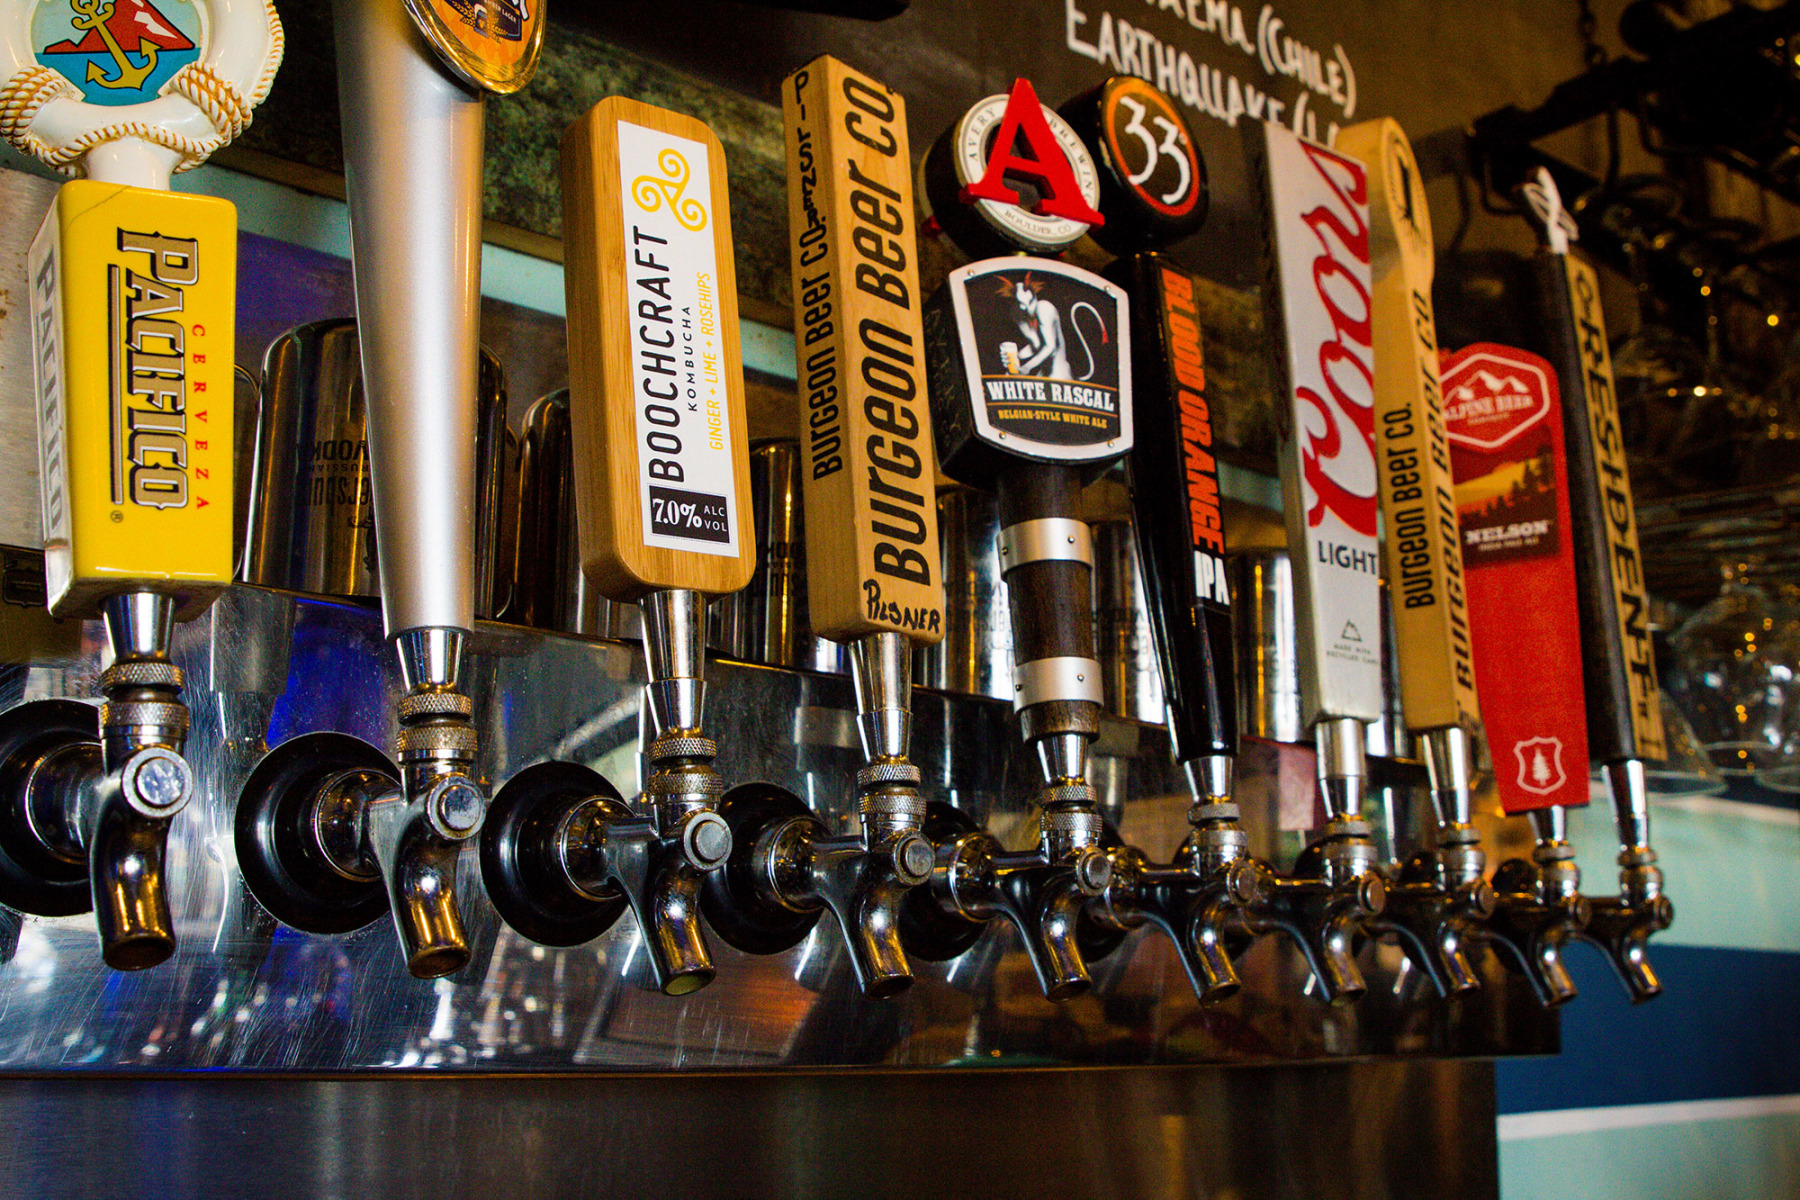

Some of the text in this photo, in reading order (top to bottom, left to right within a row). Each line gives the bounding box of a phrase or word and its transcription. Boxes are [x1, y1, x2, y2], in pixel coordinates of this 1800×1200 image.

[968, 106, 996, 161] AVERY
[968, 77, 1105, 226] A
[696, 272, 715, 336] ROSEHIPS
[633, 225, 685, 483] BOOCHCRAFT
[682, 307, 698, 411] KOMBUCHA
[1296, 138, 1378, 538] Coors
[117, 227, 199, 510] PACIFICO
[703, 352, 718, 383] LIME
[192, 323, 210, 509] CERVEZA
[986, 381, 1115, 412] WHITE RASCAL
[998, 409, 1108, 429] BELGIAN-STYLE WHITE ALE
[299, 440, 369, 461] VODK
[706, 400, 724, 450] GINGER
[1161, 267, 1231, 606] BLOOD ORANGE IPA
[652, 498, 702, 528] 7.0%
[703, 505, 725, 517] ALC
[704, 520, 727, 532] VOL
[1465, 520, 1549, 545] NELSON
[1317, 540, 1377, 575] LIGHT
[863, 579, 940, 634] PILSNER
